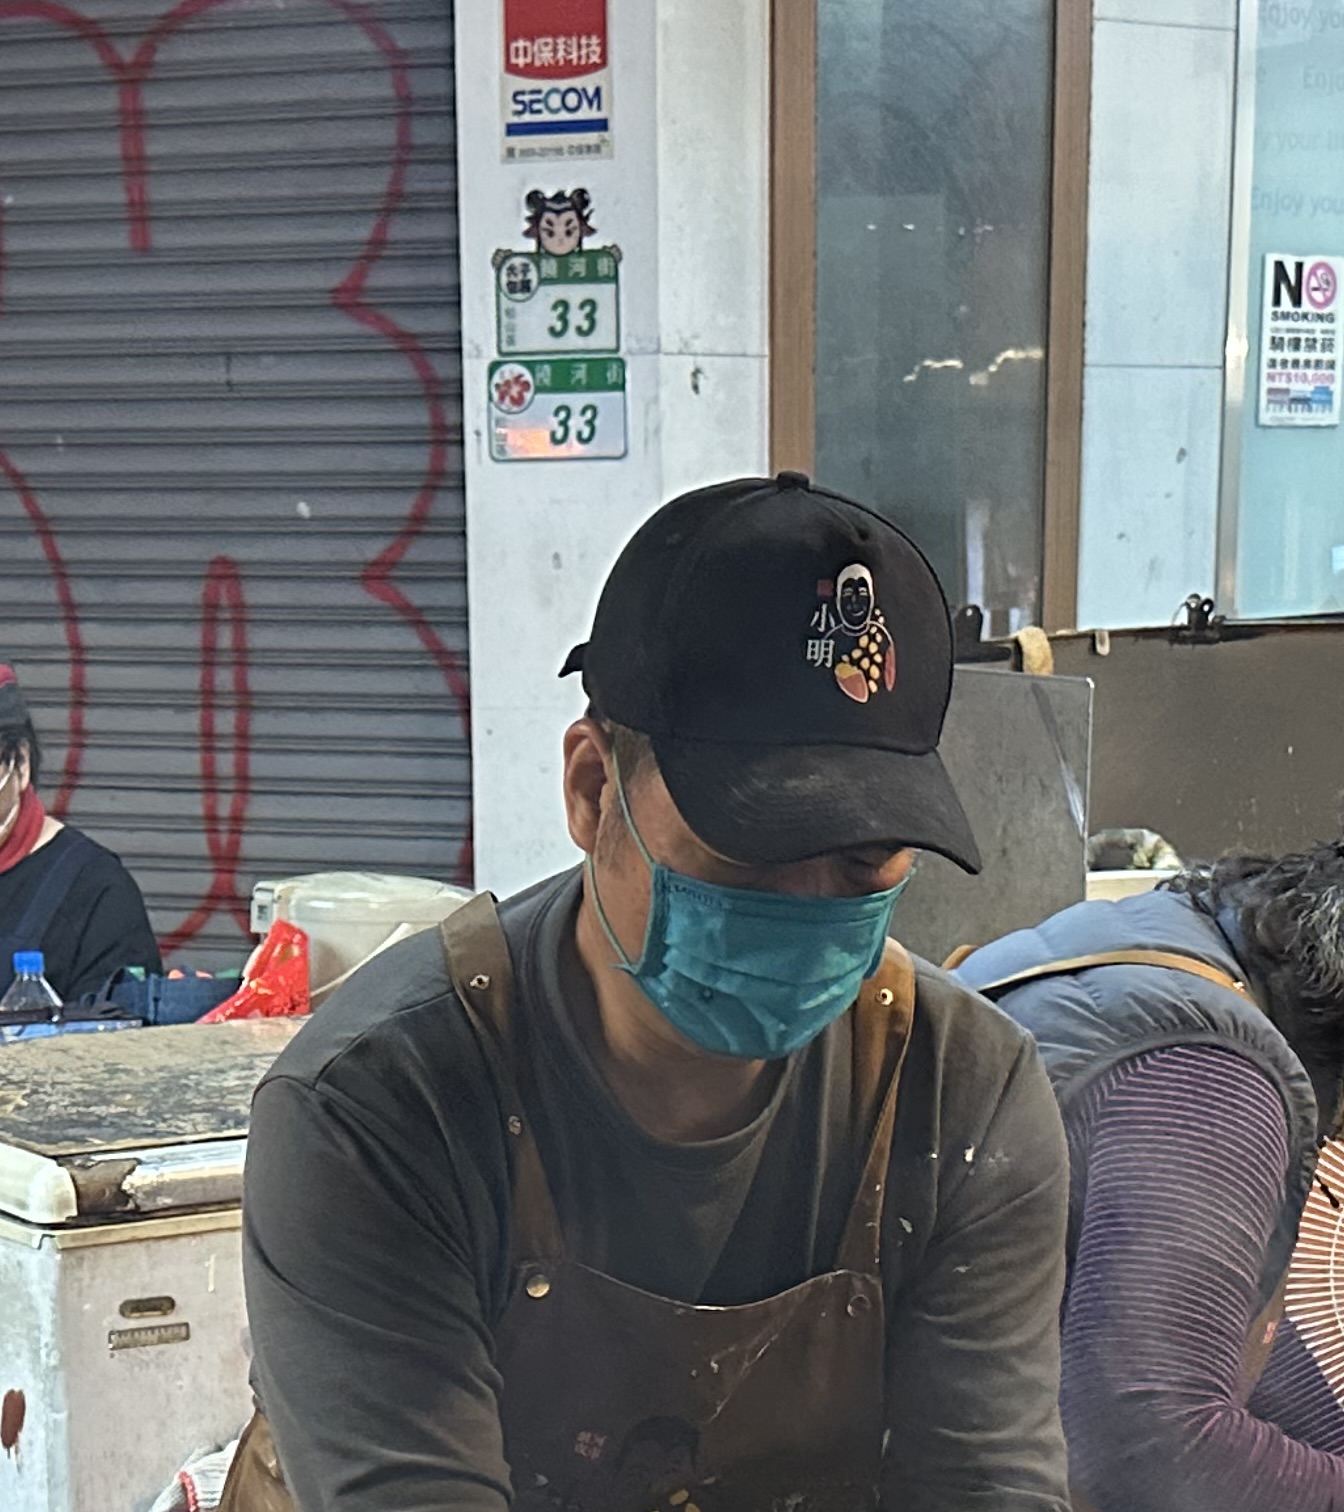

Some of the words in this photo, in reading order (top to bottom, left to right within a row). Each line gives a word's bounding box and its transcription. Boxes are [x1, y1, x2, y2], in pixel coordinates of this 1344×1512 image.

[509, 36, 602, 68] 中保科技
[512, 86, 601, 116] SECOM
[548, 299, 598, 338] 33
[1271, 310, 1336, 324] SMOKING
[550, 404, 598, 445] 33
[806, 603, 835, 668] 小明
